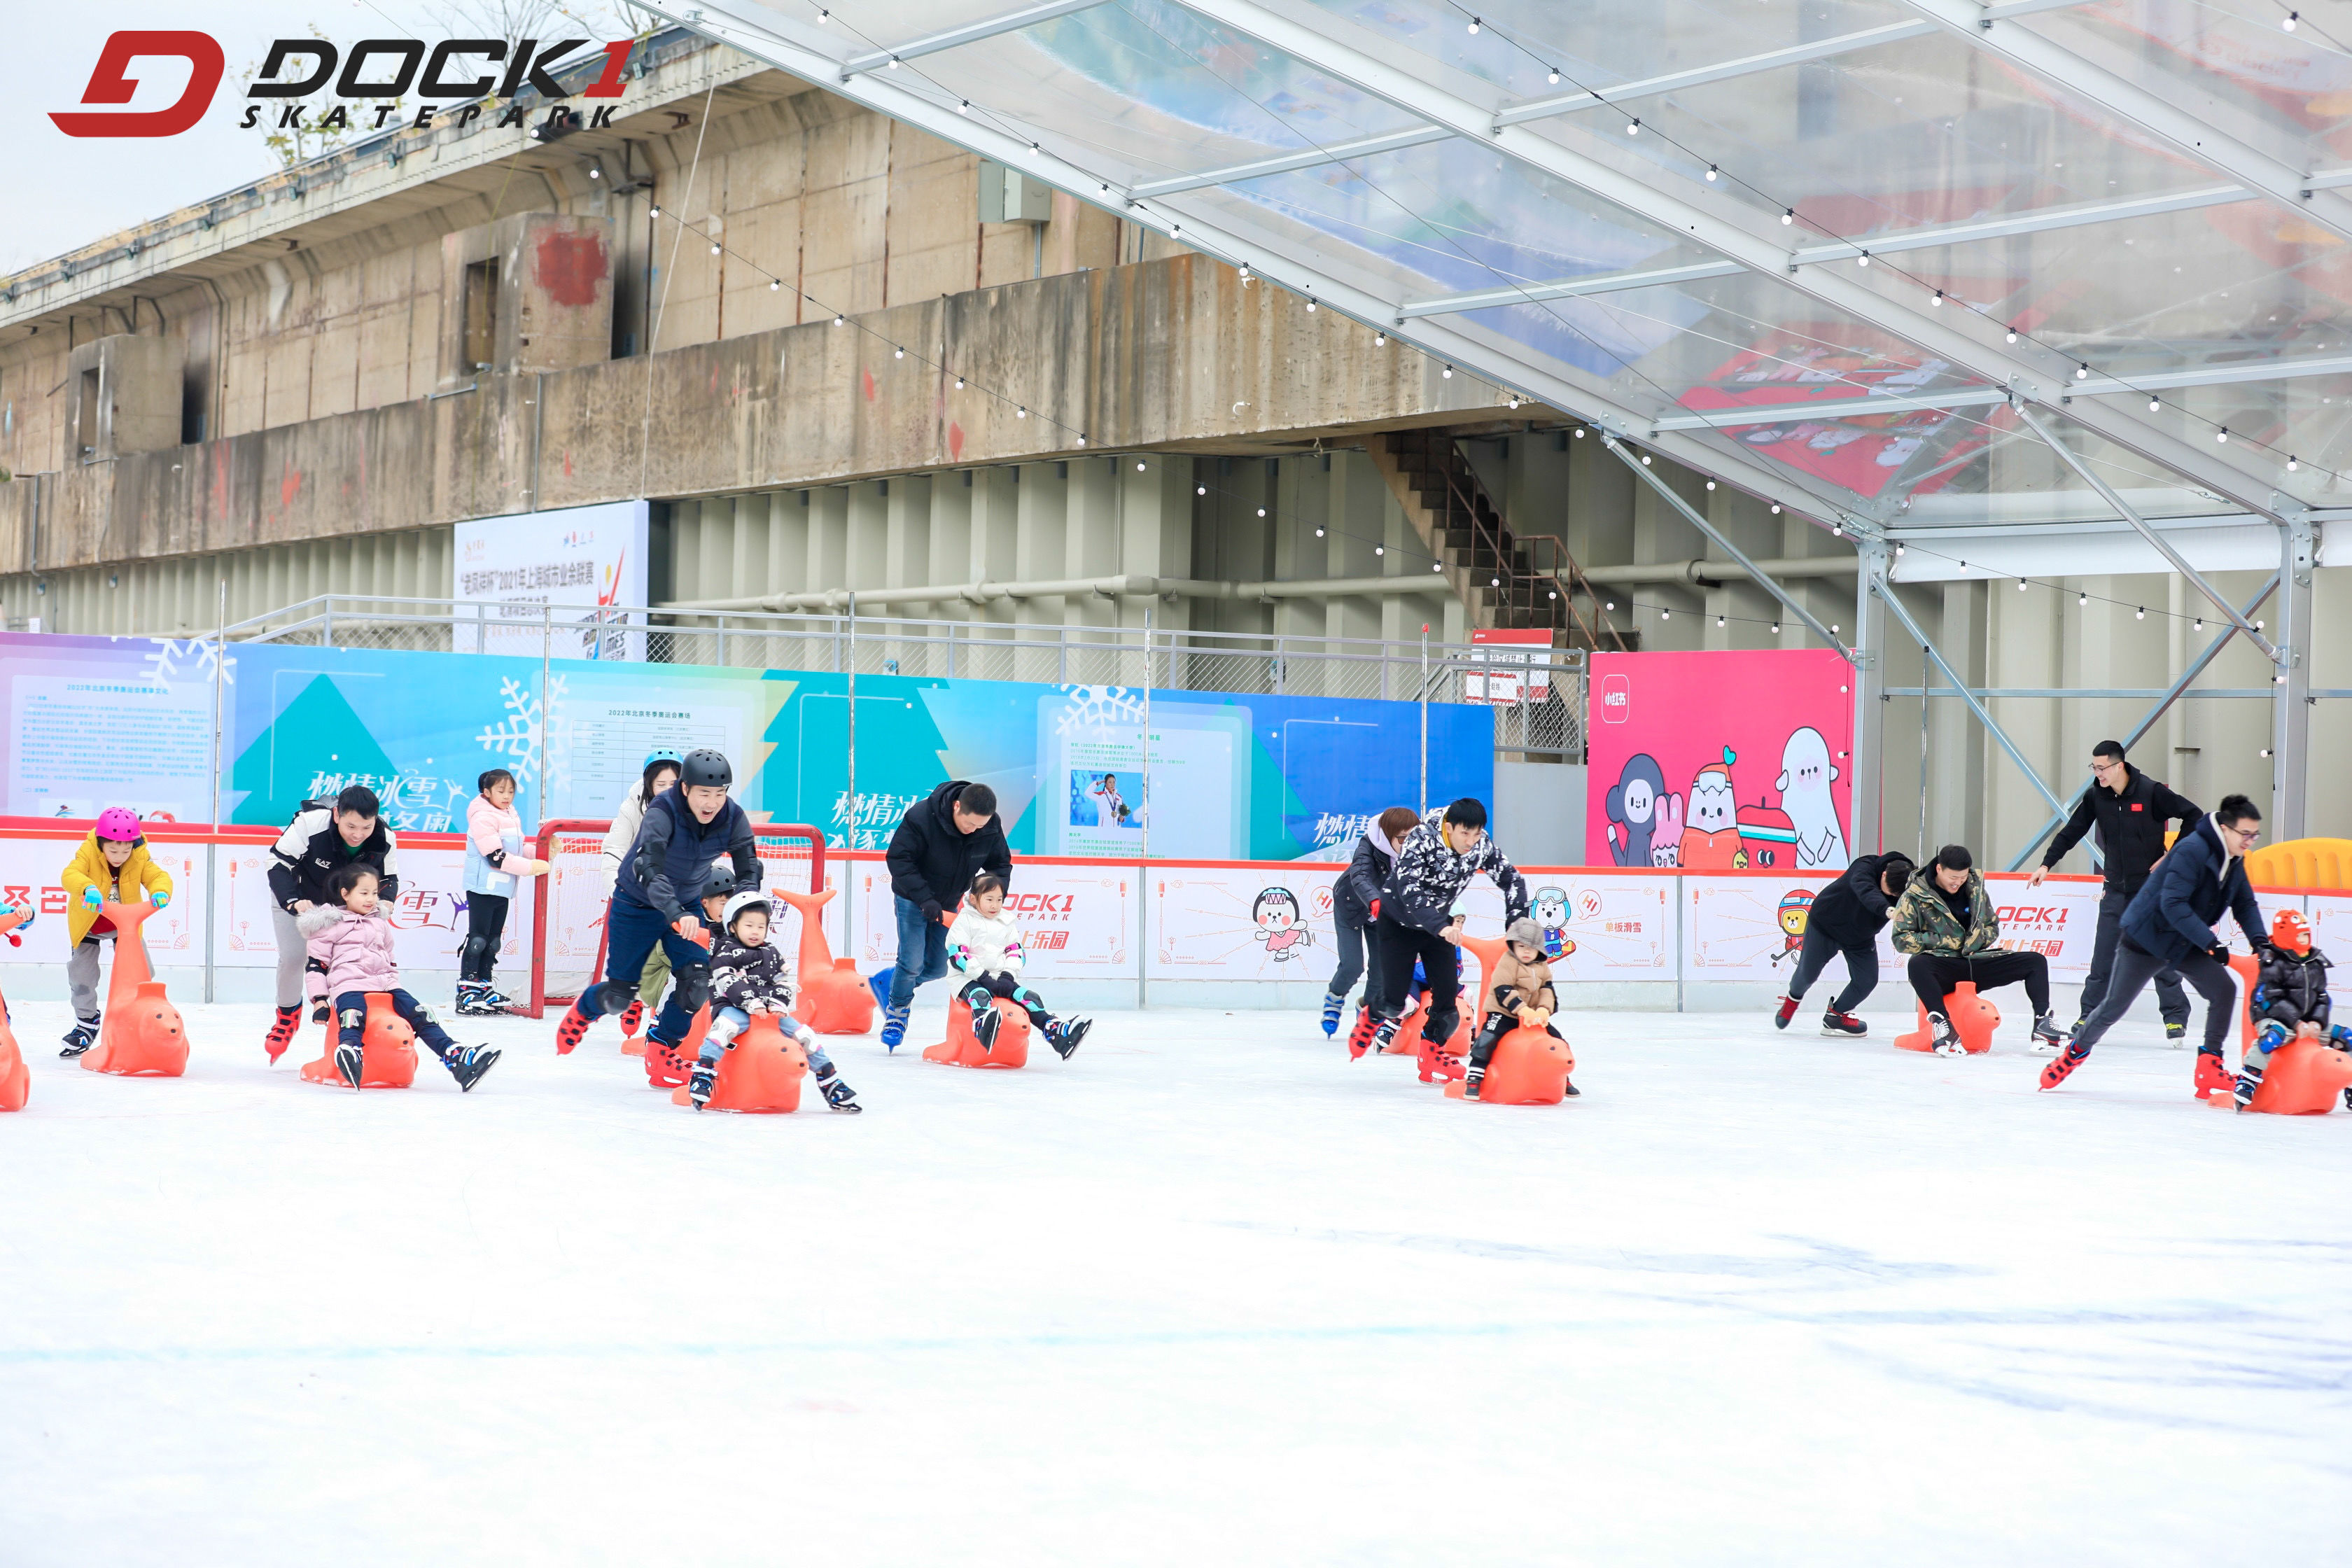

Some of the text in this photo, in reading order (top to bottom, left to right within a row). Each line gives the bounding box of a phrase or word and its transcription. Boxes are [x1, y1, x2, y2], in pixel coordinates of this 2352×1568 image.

[1605, 692, 1626, 706] 小红书
[608, 709, 691, 719] 2022年北京冬季奥运会赛场
[1582, 895, 1597, 911] HI
[1604, 922, 1642, 933] 单板滑雪
